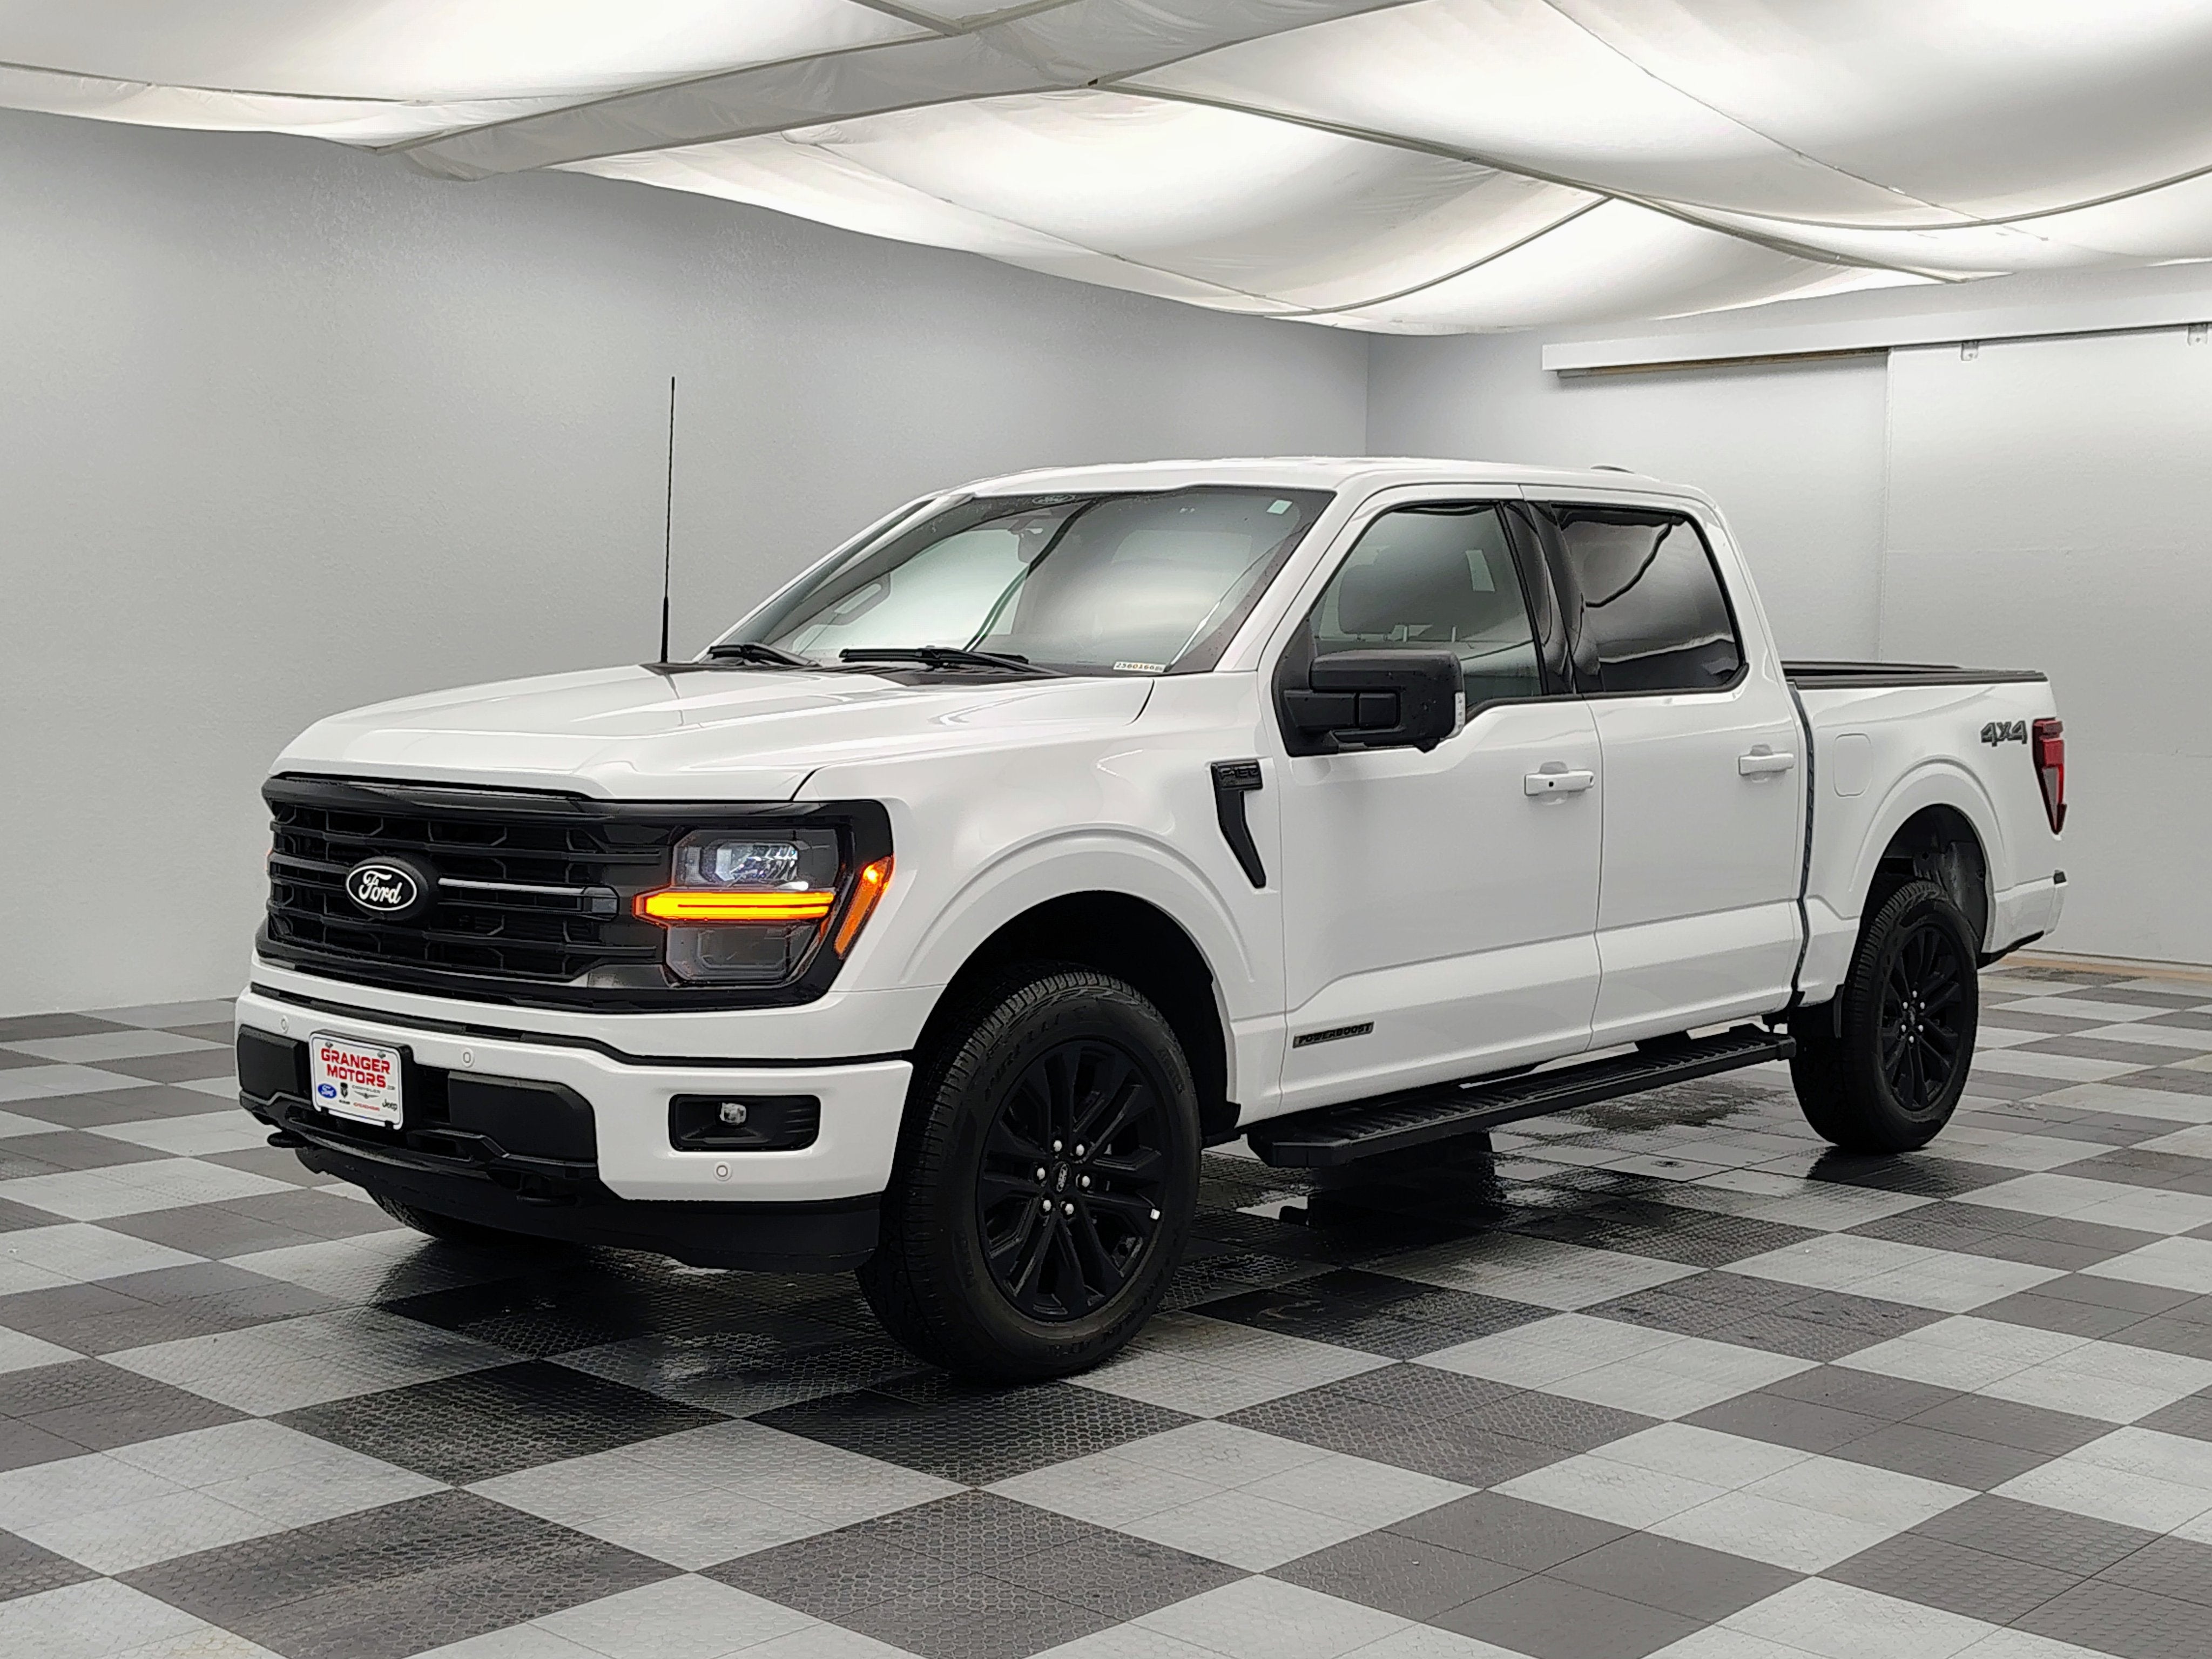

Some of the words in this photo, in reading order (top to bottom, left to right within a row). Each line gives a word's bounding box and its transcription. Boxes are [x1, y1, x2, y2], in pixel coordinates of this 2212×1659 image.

[359, 870, 403, 904] Ford
[1298, 1023, 1372, 1044] POWERBOOST
[321, 1048, 390, 1075] GRANGER
[327, 1063, 386, 1088] MOTORS
